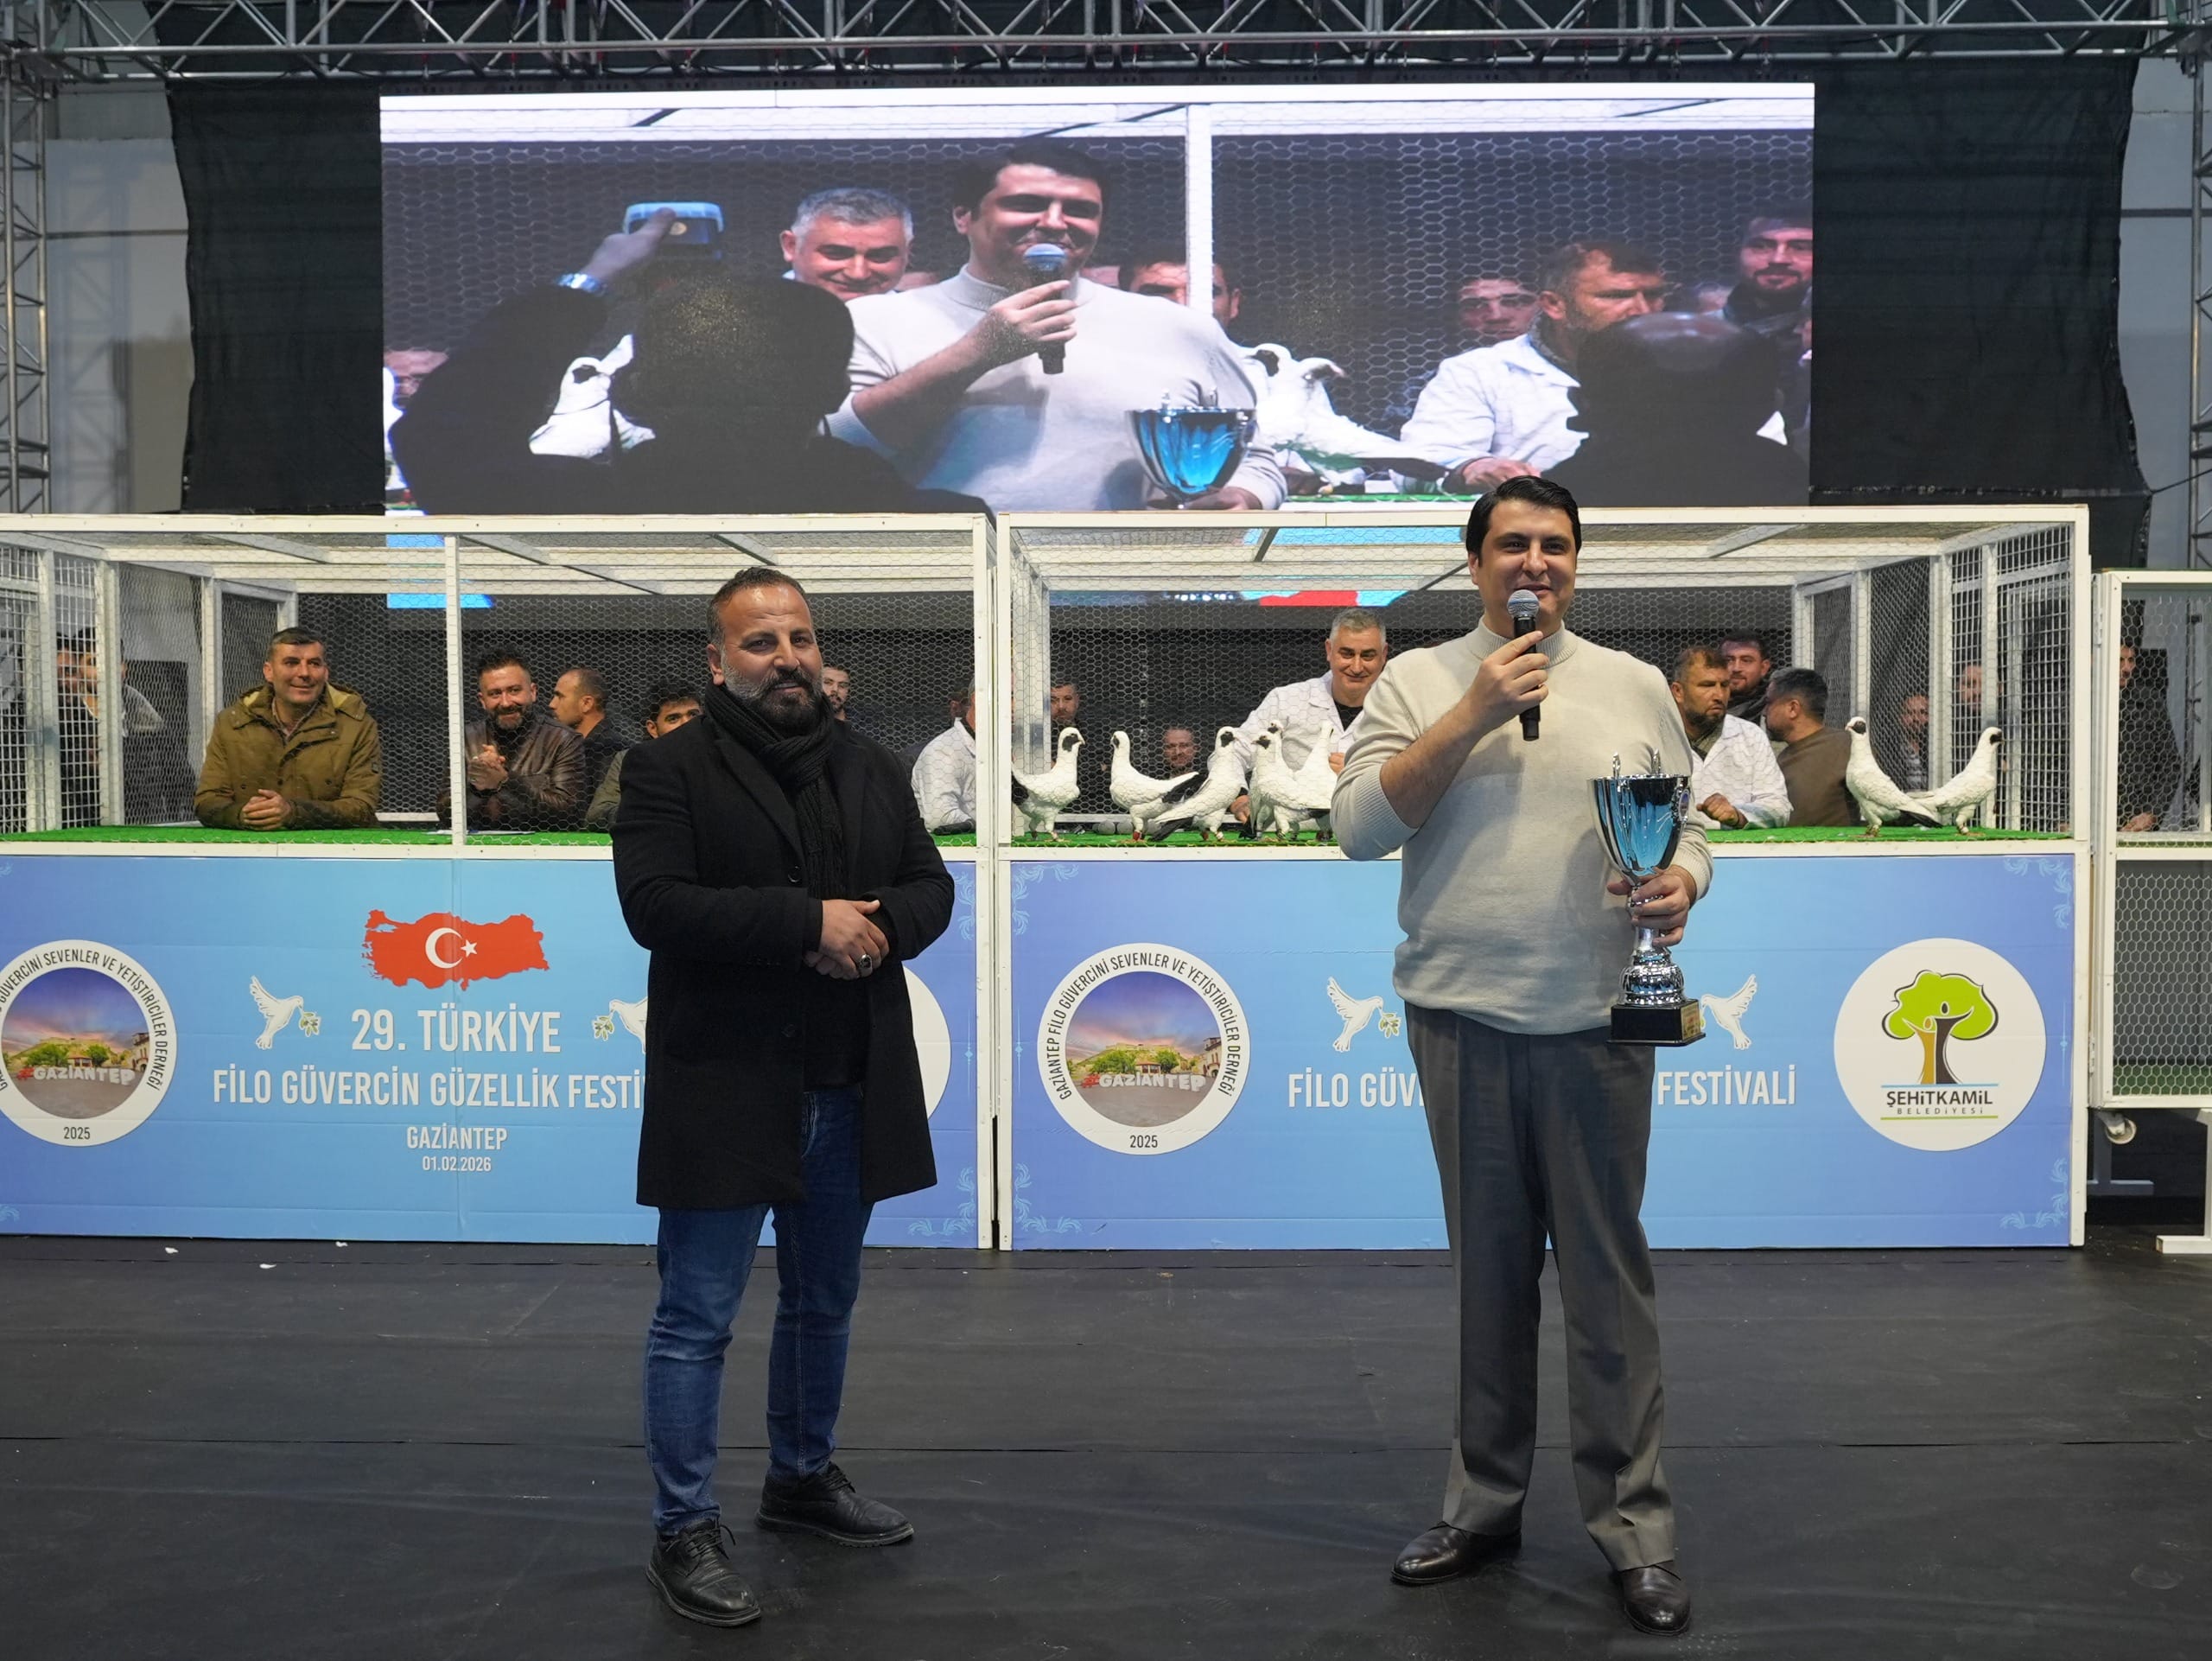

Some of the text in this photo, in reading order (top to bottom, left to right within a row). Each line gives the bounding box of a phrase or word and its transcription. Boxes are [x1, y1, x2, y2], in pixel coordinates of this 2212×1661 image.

[42, 949, 99, 966] SEVENLER
[103, 954, 118, 971] VE
[118, 963, 167, 1037] YETİŞTİRİCİLER
[146, 1041, 168, 1091] DERNEĞİ
[351, 1002, 562, 1053] 29. TÜRKİYE
[1046, 952, 1242, 1100] GAZİANTEP FİLO GÜVERCİNİ SEVENLER VE YETİŞTİRİCİLER DERNEĞİ
[213, 1063, 645, 1109] FİLO GÜVERCİN GÜZELLİK FESTİ
[1288, 1066, 1425, 1108] FİLO GÜV
[1657, 1064, 1796, 1106] FESTİVALİ
[63, 1126, 91, 1140] 2025
[406, 1123, 508, 1150] GAZİANTEP
[1129, 1135, 1159, 1149] 2025
[422, 1155, 492, 1173] 01.02.2026
